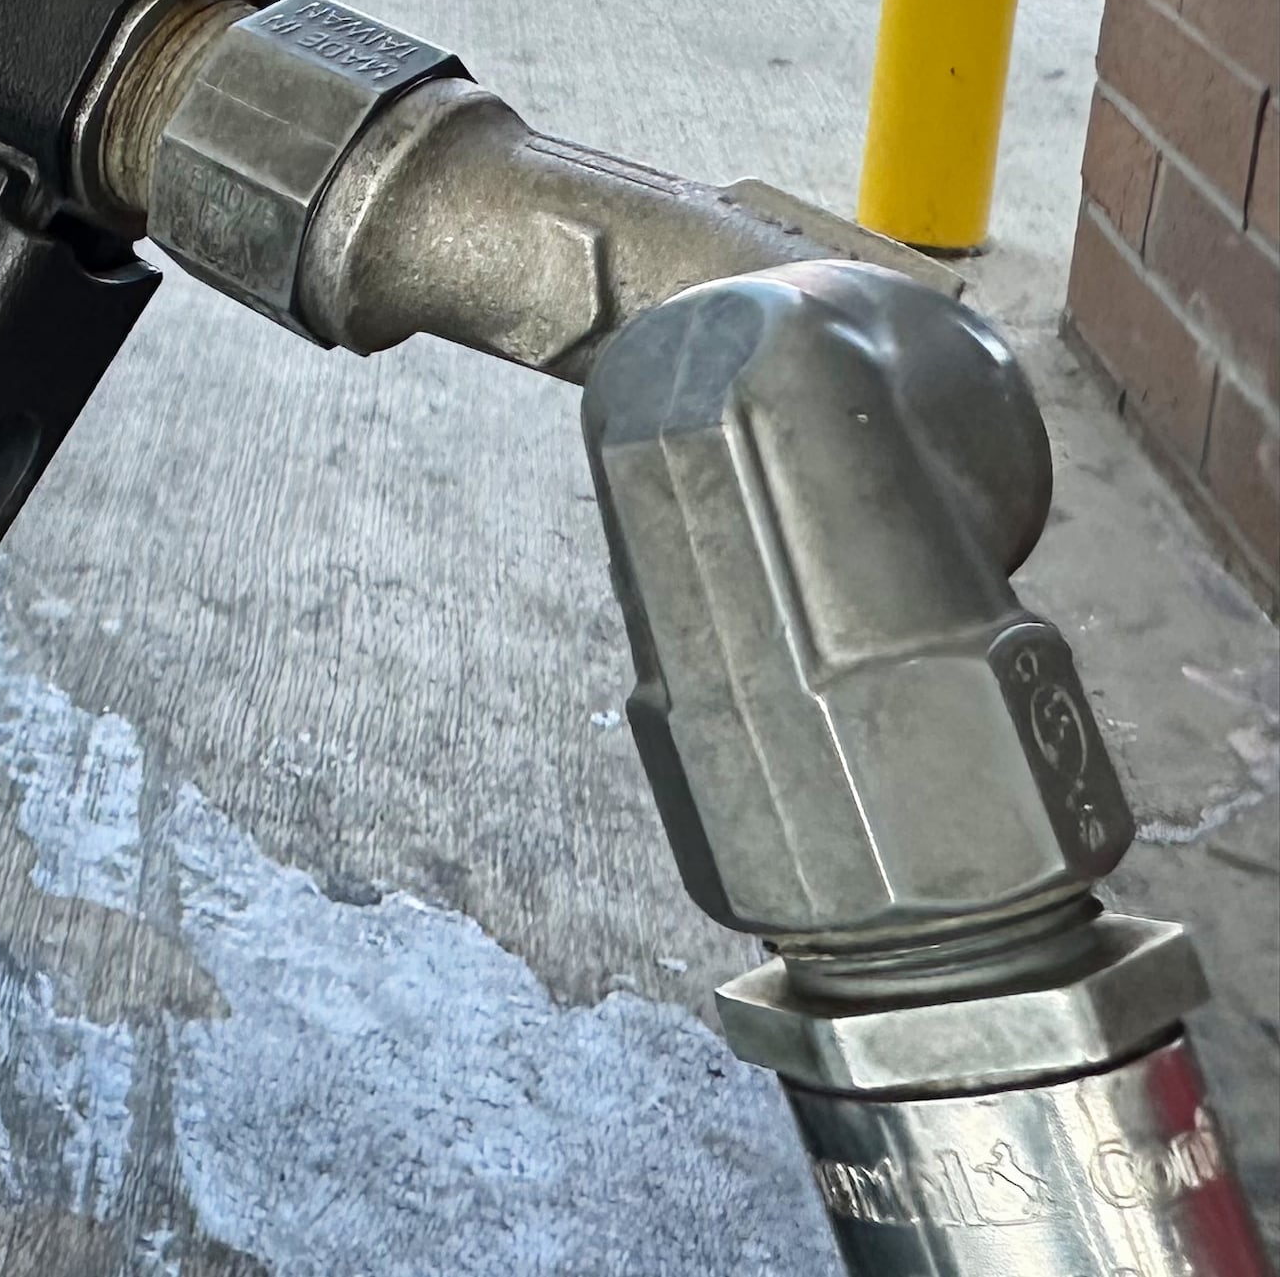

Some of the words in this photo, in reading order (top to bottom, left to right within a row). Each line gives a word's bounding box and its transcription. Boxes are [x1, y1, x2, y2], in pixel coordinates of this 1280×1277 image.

[260, 13, 302, 35] IN
[296, 1, 418, 61] TAIWAN
[297, 31, 398, 81] MADE
